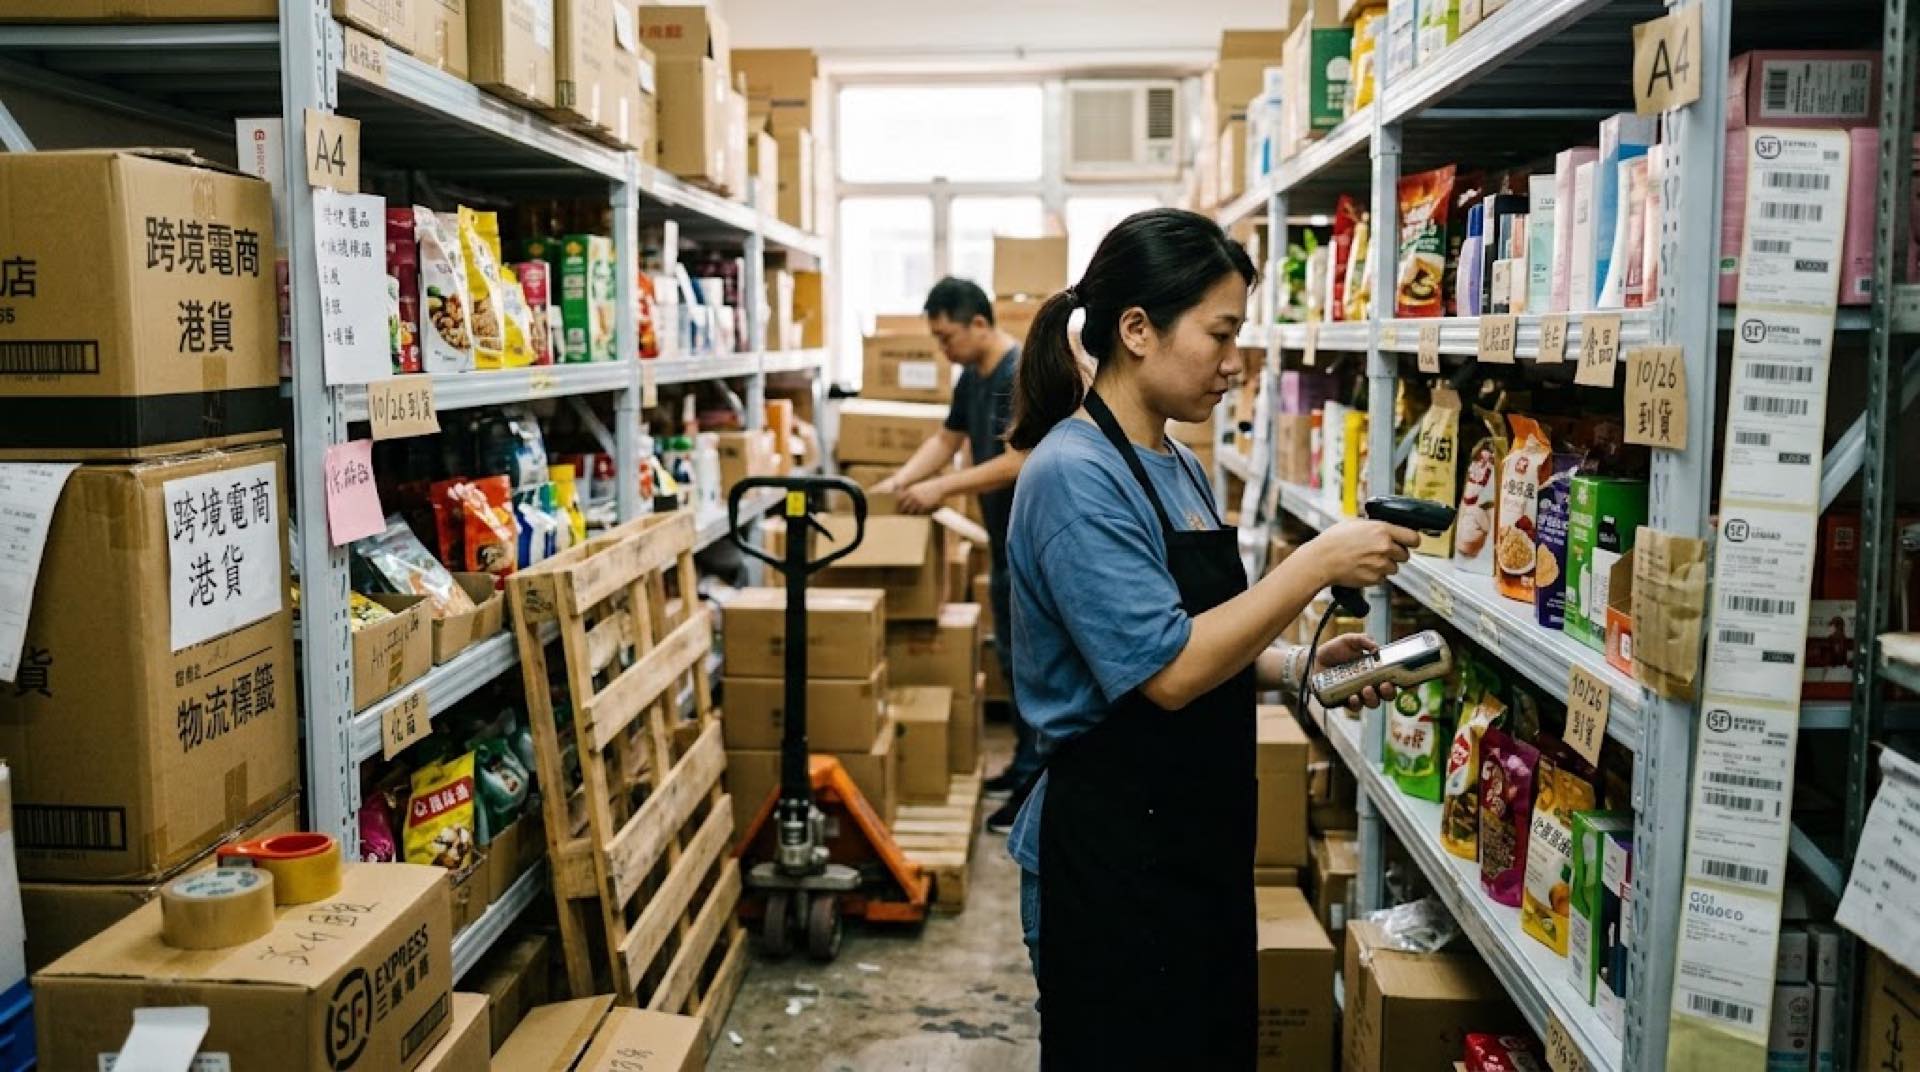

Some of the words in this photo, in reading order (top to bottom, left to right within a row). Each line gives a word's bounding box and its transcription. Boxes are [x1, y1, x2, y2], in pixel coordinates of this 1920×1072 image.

[1647, 26, 1690, 98] A4
[314, 128, 346, 177] A4
[0, 256, 36, 297] 店
[145, 216, 260, 278] 跨境電商
[177, 299, 234, 352] 港貨
[1636, 352, 1677, 392] 10/26
[173, 477, 270, 545] 跨境電商
[188, 544, 245, 608] 港貨
[177, 662, 276, 754] 物流標籤
